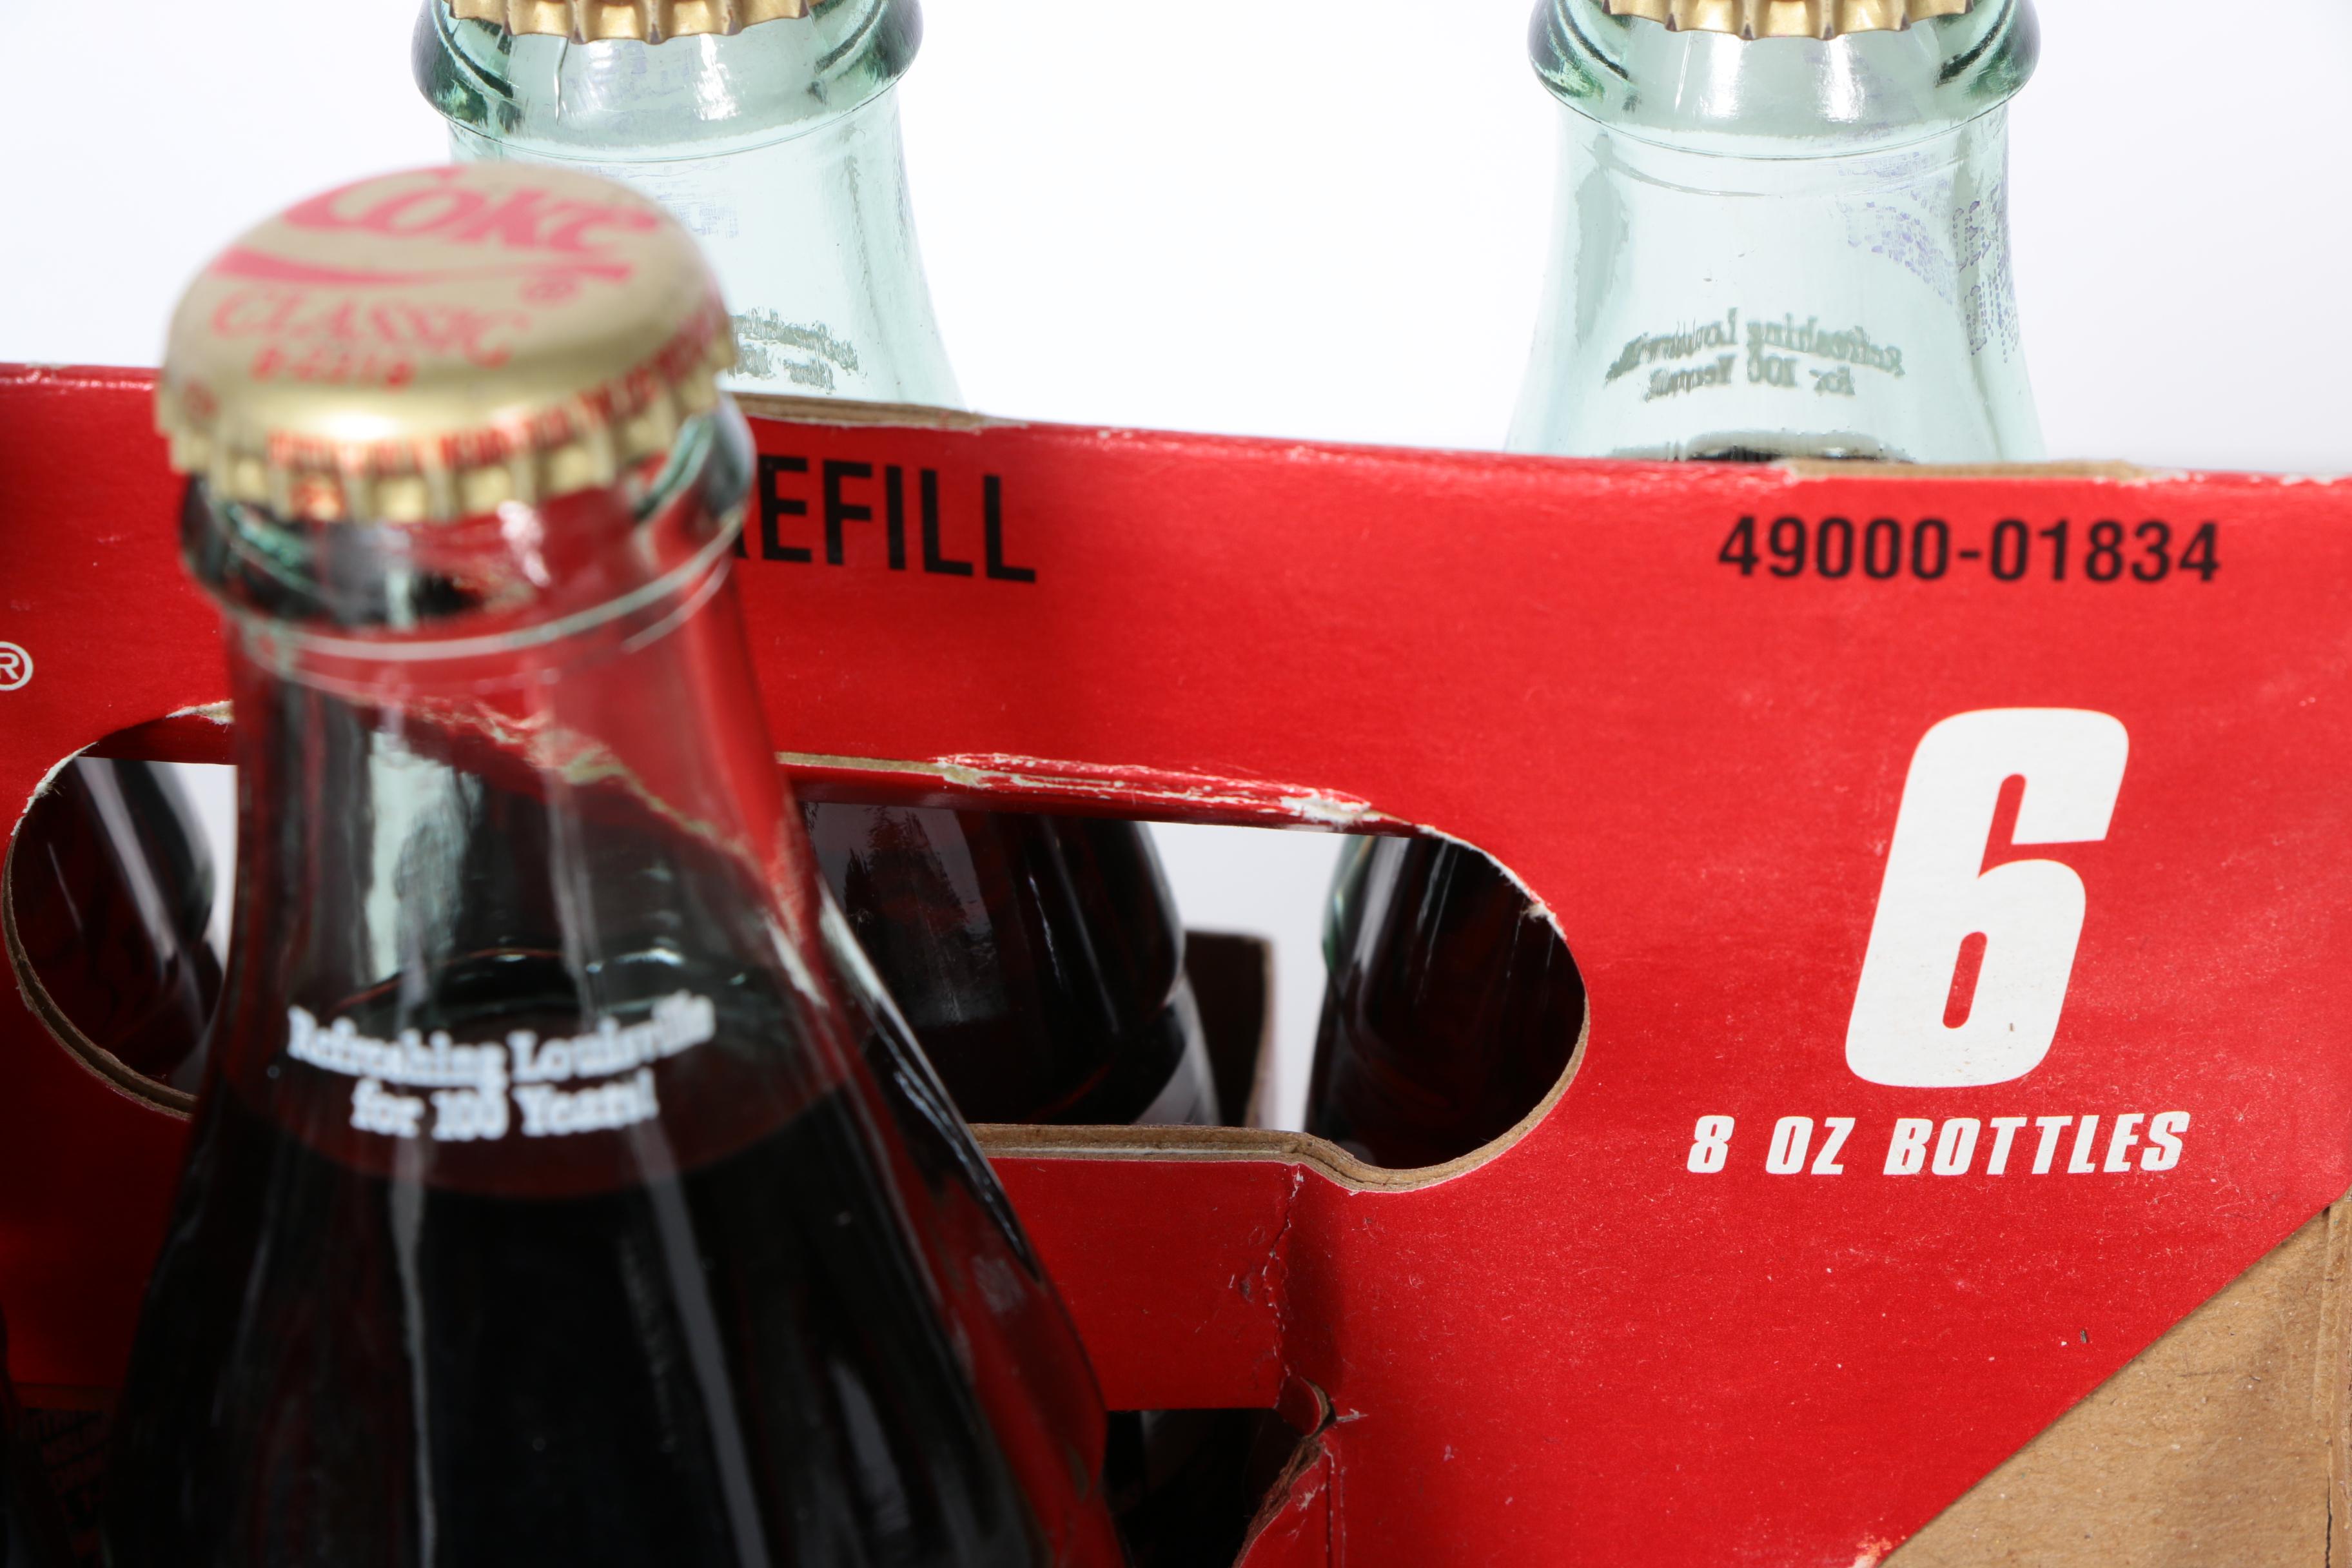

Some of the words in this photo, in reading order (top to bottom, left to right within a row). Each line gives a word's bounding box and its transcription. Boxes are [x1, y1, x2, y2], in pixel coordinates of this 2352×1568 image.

[734, 454, 1037, 584] EFILL
[1718, 514, 2220, 582] 49000-01834
[1845, 707, 2129, 1088] 6
[1687, 1115, 1735, 1173] 8
[1765, 1116, 1856, 1175] OZ
[1883, 1110, 2191, 1175] BOTTLES
